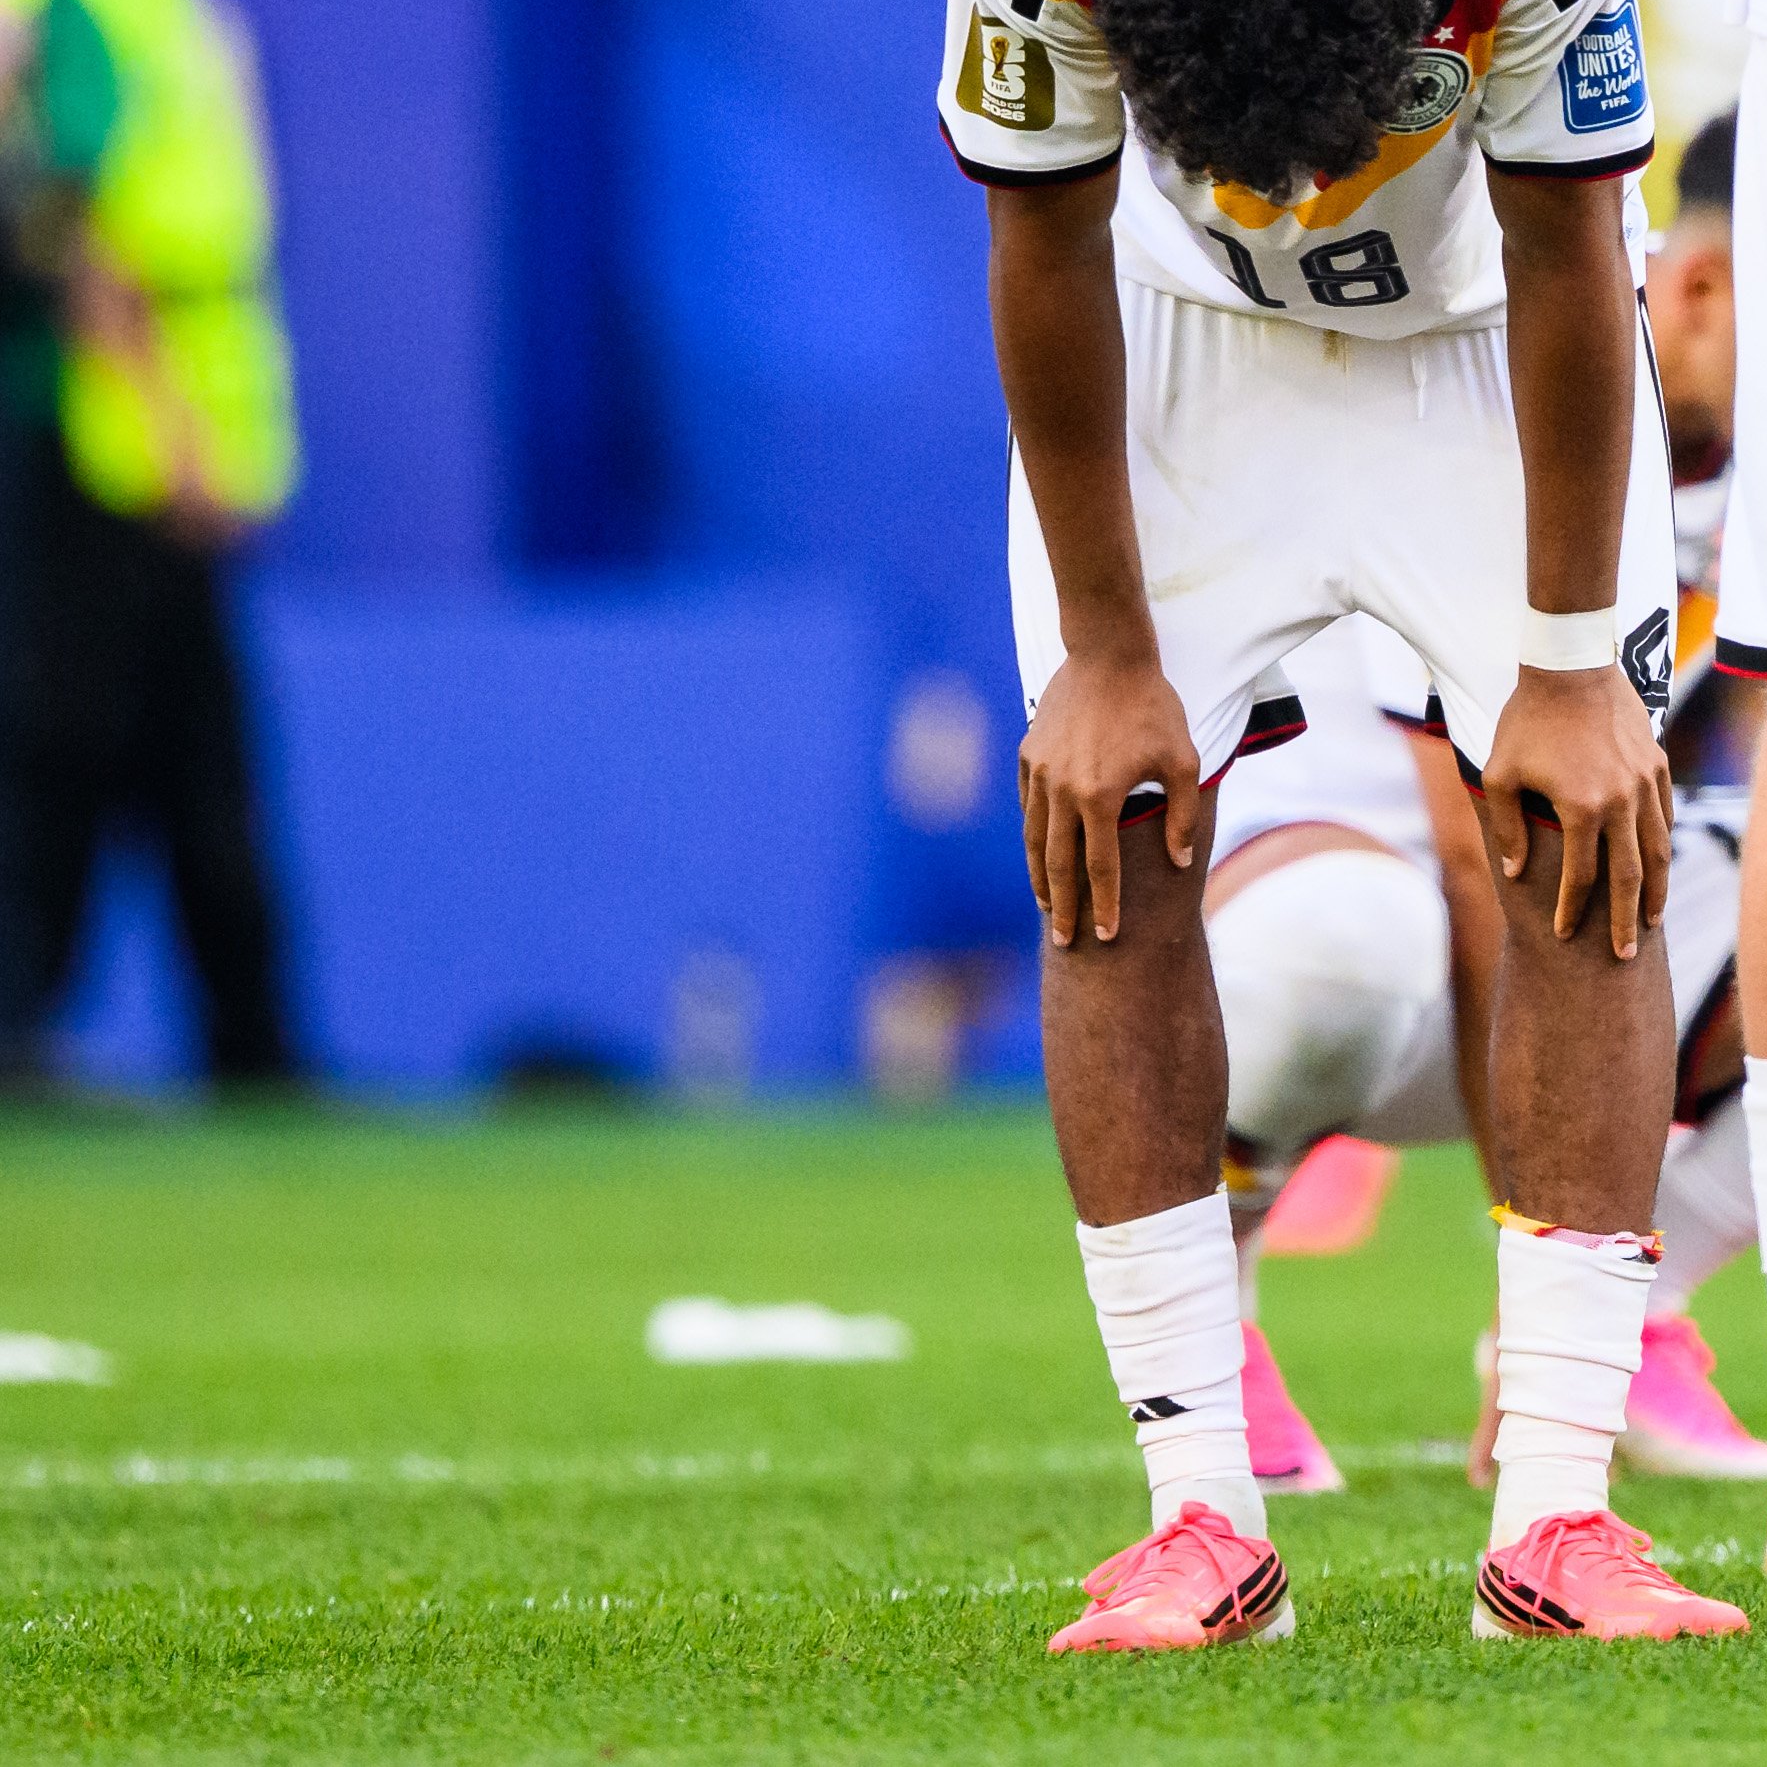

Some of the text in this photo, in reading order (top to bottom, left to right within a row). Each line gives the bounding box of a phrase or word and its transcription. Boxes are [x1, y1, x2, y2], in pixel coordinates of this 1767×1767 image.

[1575, 24, 1632, 52] FOOTBALL
[1577, 40, 1636, 77] UNITES
[1576, 60, 1643, 100] the World
[981, 97, 1026, 122] 2026
[1601, 96, 1631, 111] FIFA
[1204, 225, 1411, 309] 18
